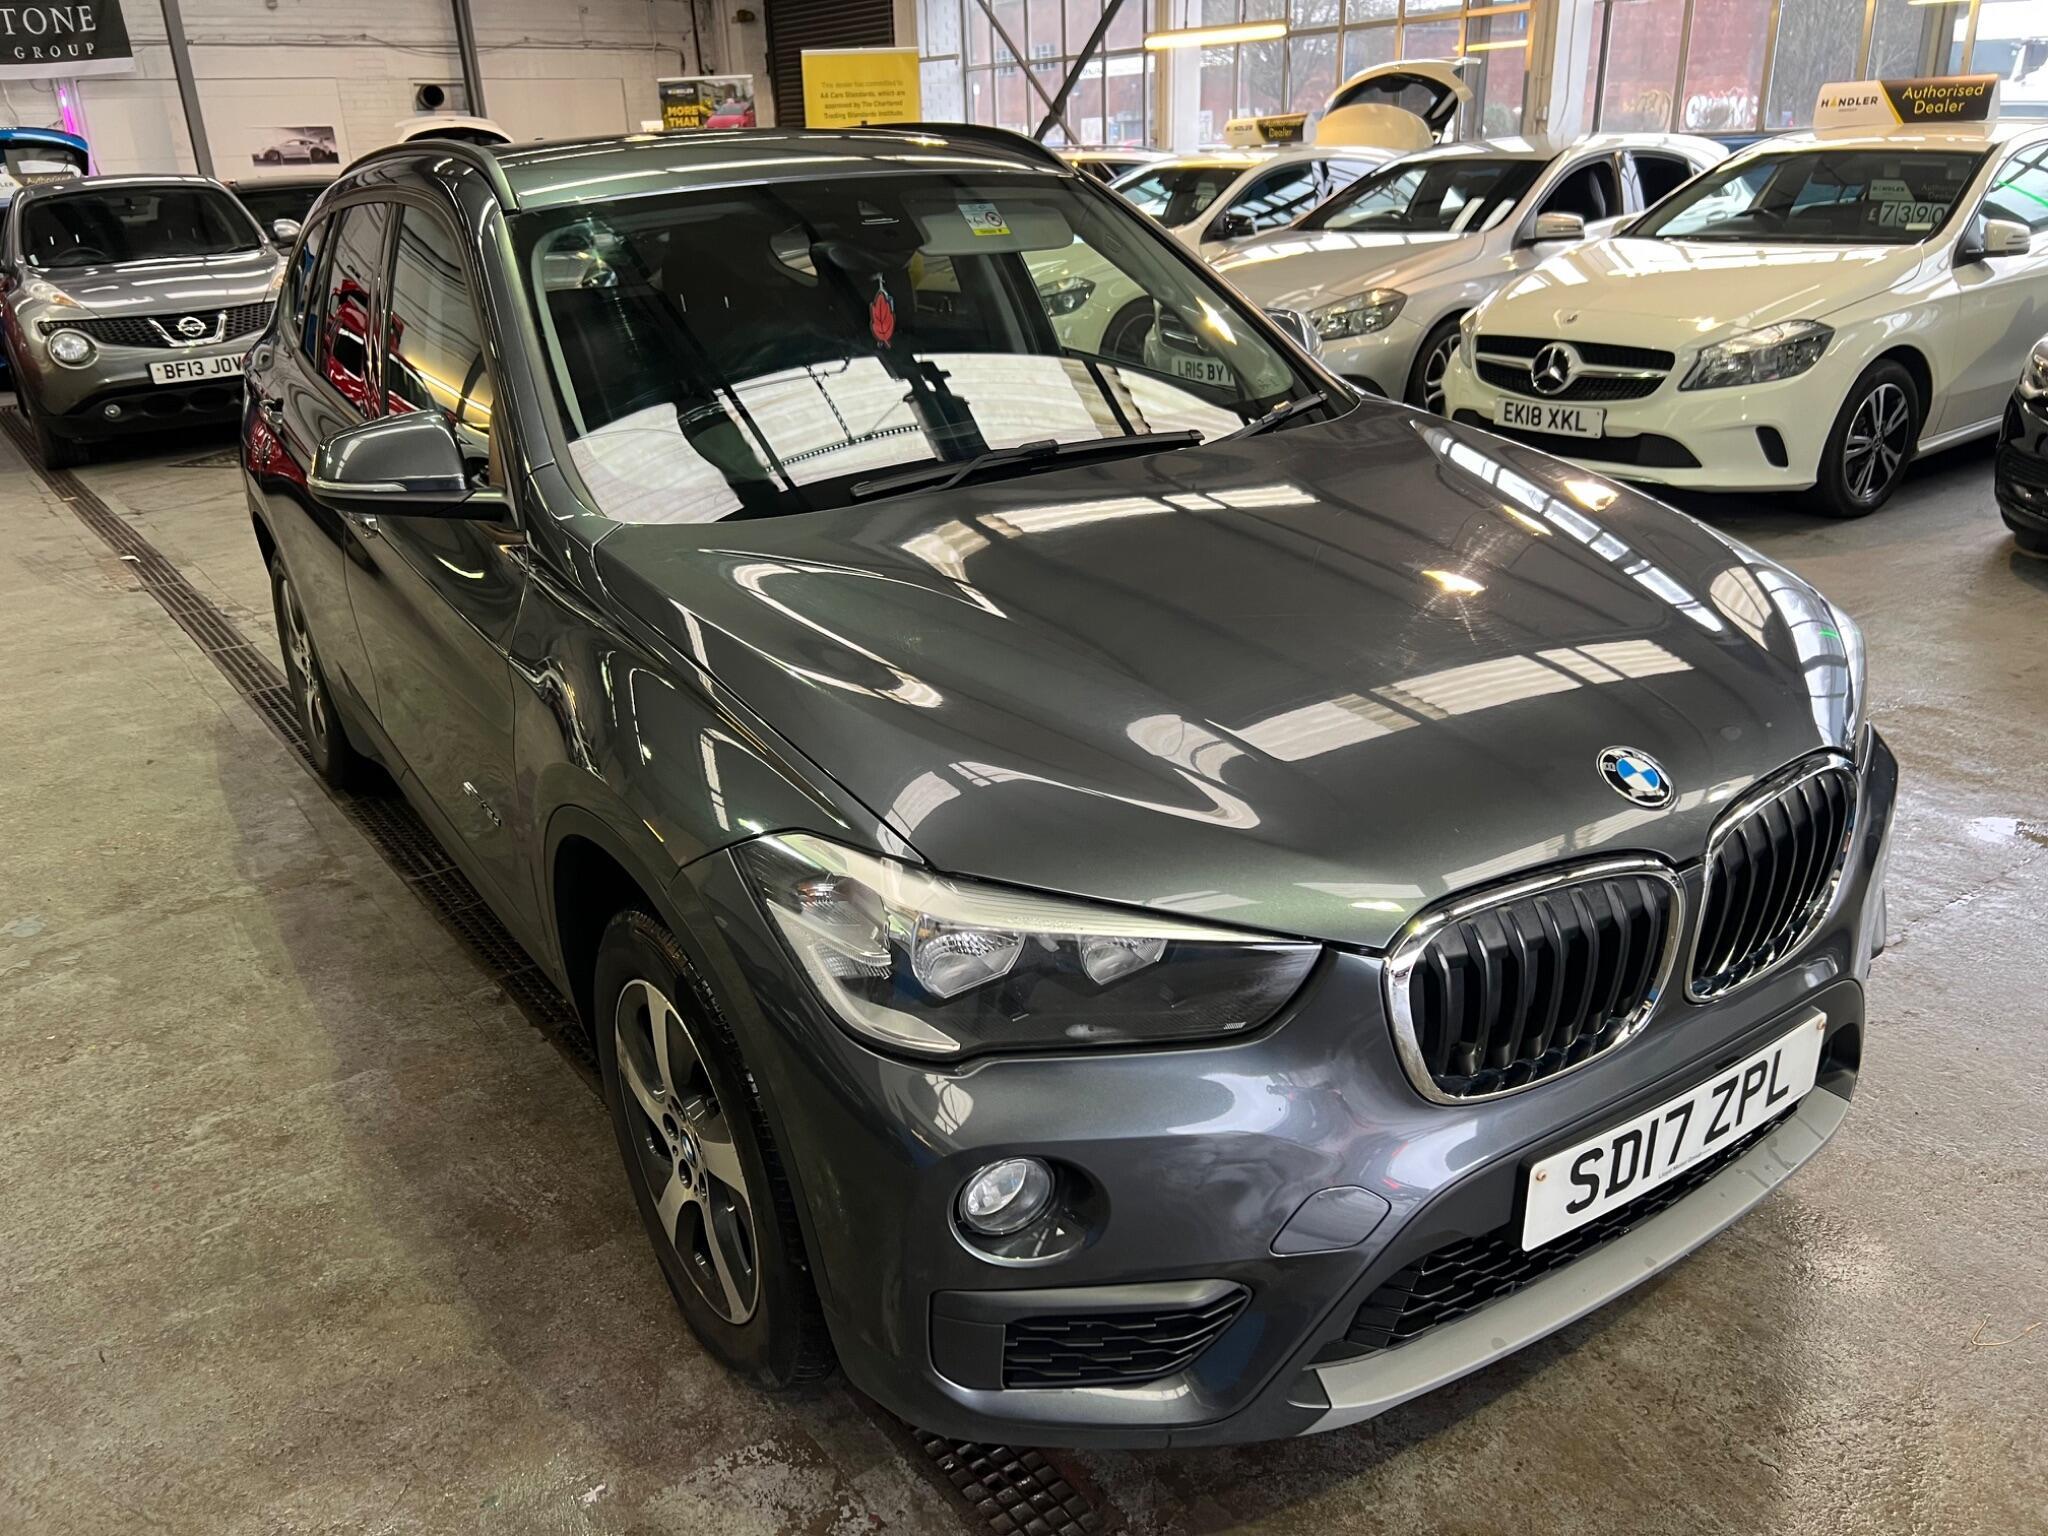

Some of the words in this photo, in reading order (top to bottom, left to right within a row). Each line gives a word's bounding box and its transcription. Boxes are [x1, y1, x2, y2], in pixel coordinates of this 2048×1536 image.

[0, 5, 96, 35] TONE
[14, 42, 95, 59] GROUP
[1902, 80, 1984, 100] Authorised
[667, 105, 698, 116] MORE
[1821, 96, 1878, 108] HANDLER
[1914, 100, 1966, 114] Dealer
[668, 117, 700, 127] THAN
[163, 361, 205, 379] BF13
[1177, 361, 1204, 379] LR15
[1504, 402, 1541, 427] EK18
[1548, 408, 1587, 432] XKL
[1566, 1099, 1695, 1215] SD17
[1704, 1048, 1789, 1146] ZPL
